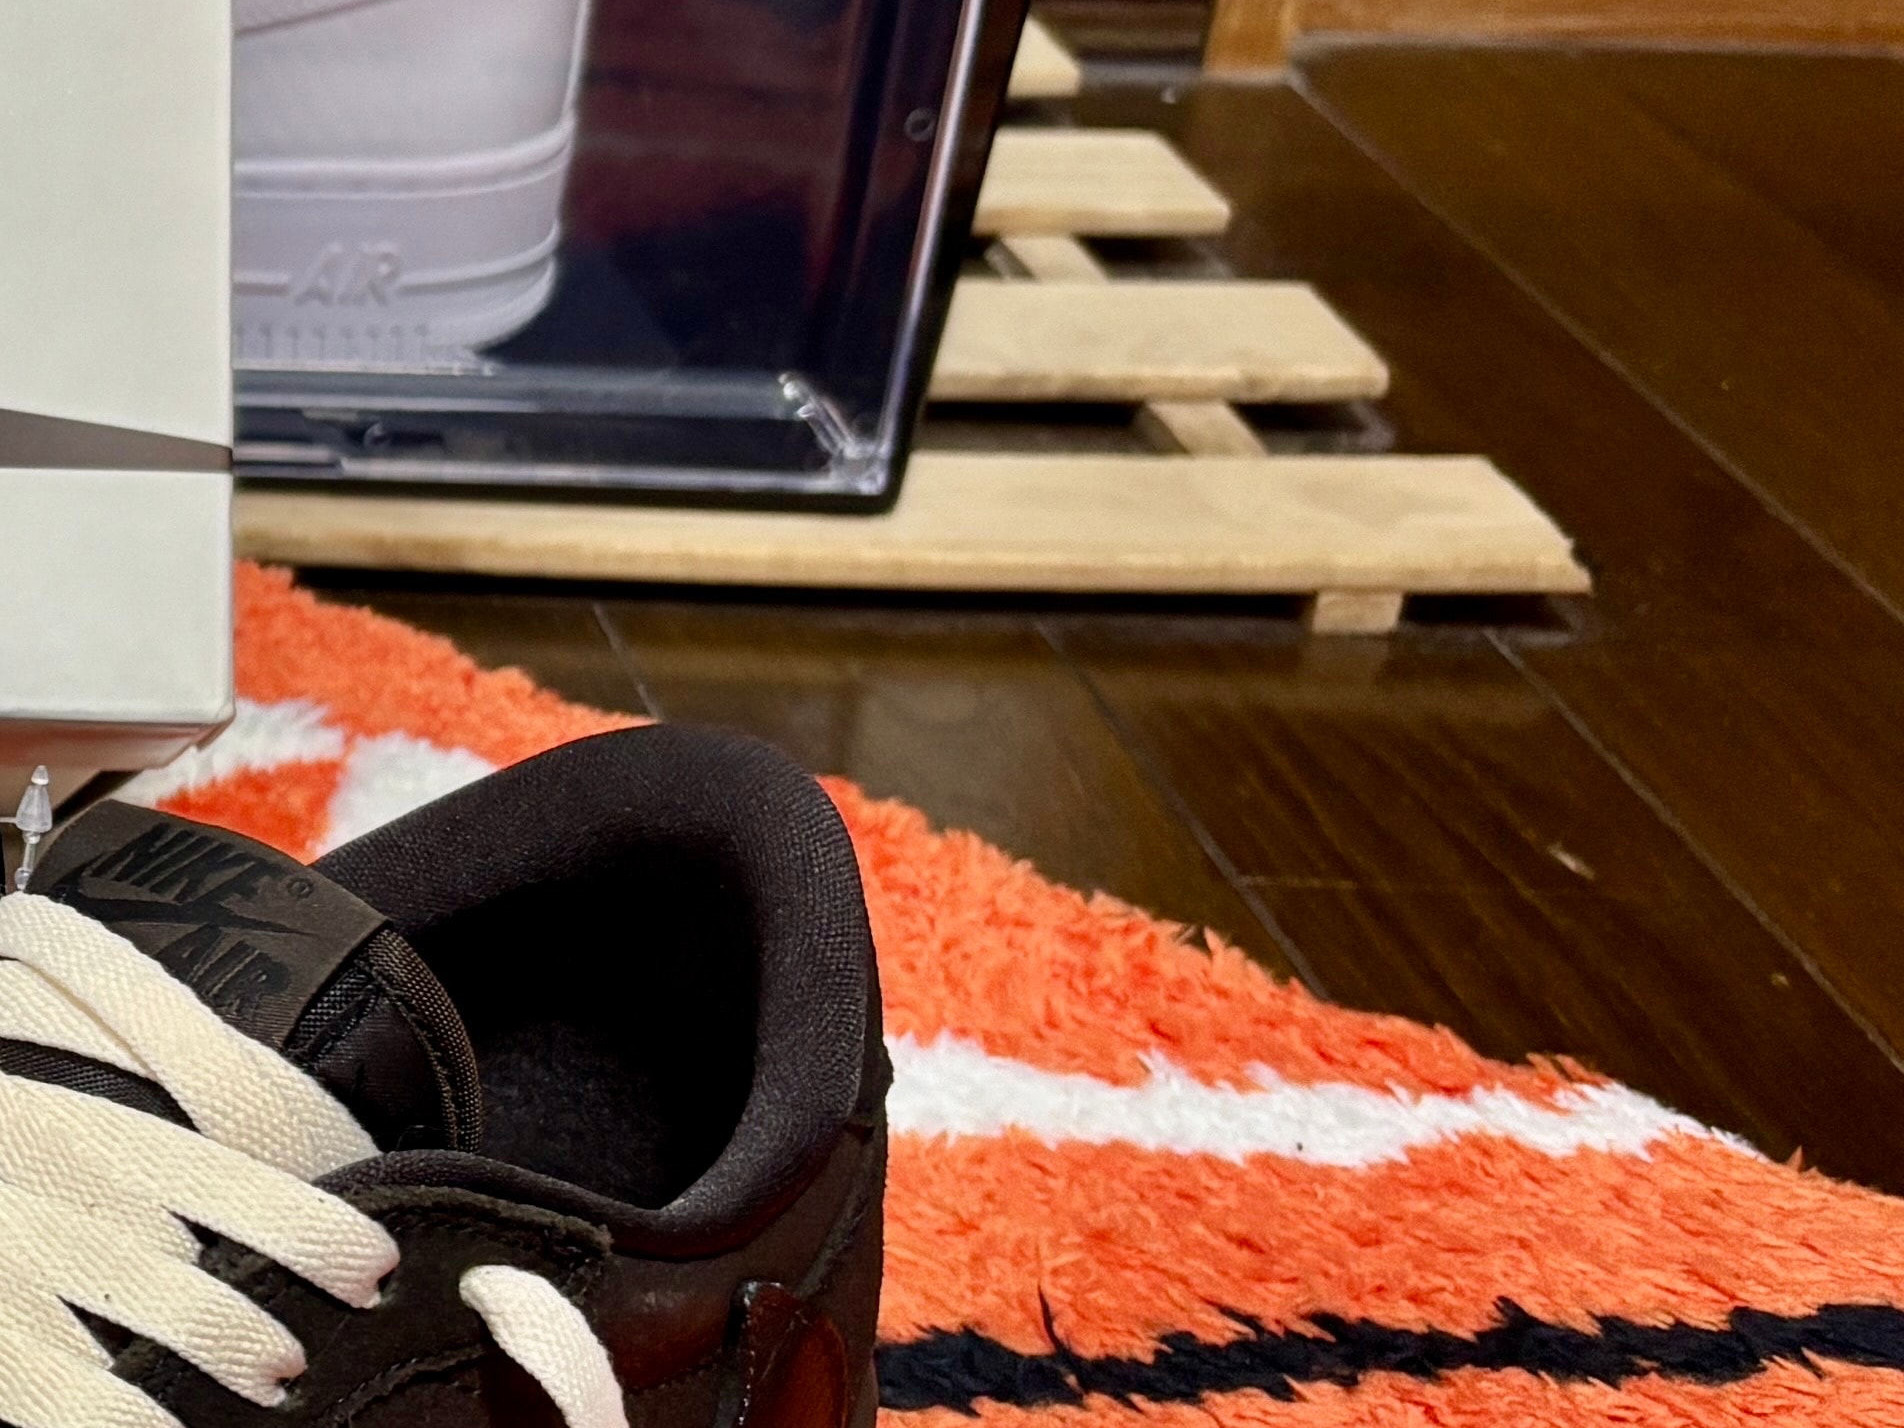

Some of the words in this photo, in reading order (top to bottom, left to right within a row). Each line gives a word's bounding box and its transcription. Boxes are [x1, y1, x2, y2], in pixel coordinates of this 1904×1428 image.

[292, 240, 402, 307] AIR
[84, 823, 286, 910] NIKE
[154, 925, 291, 1019] AIR
